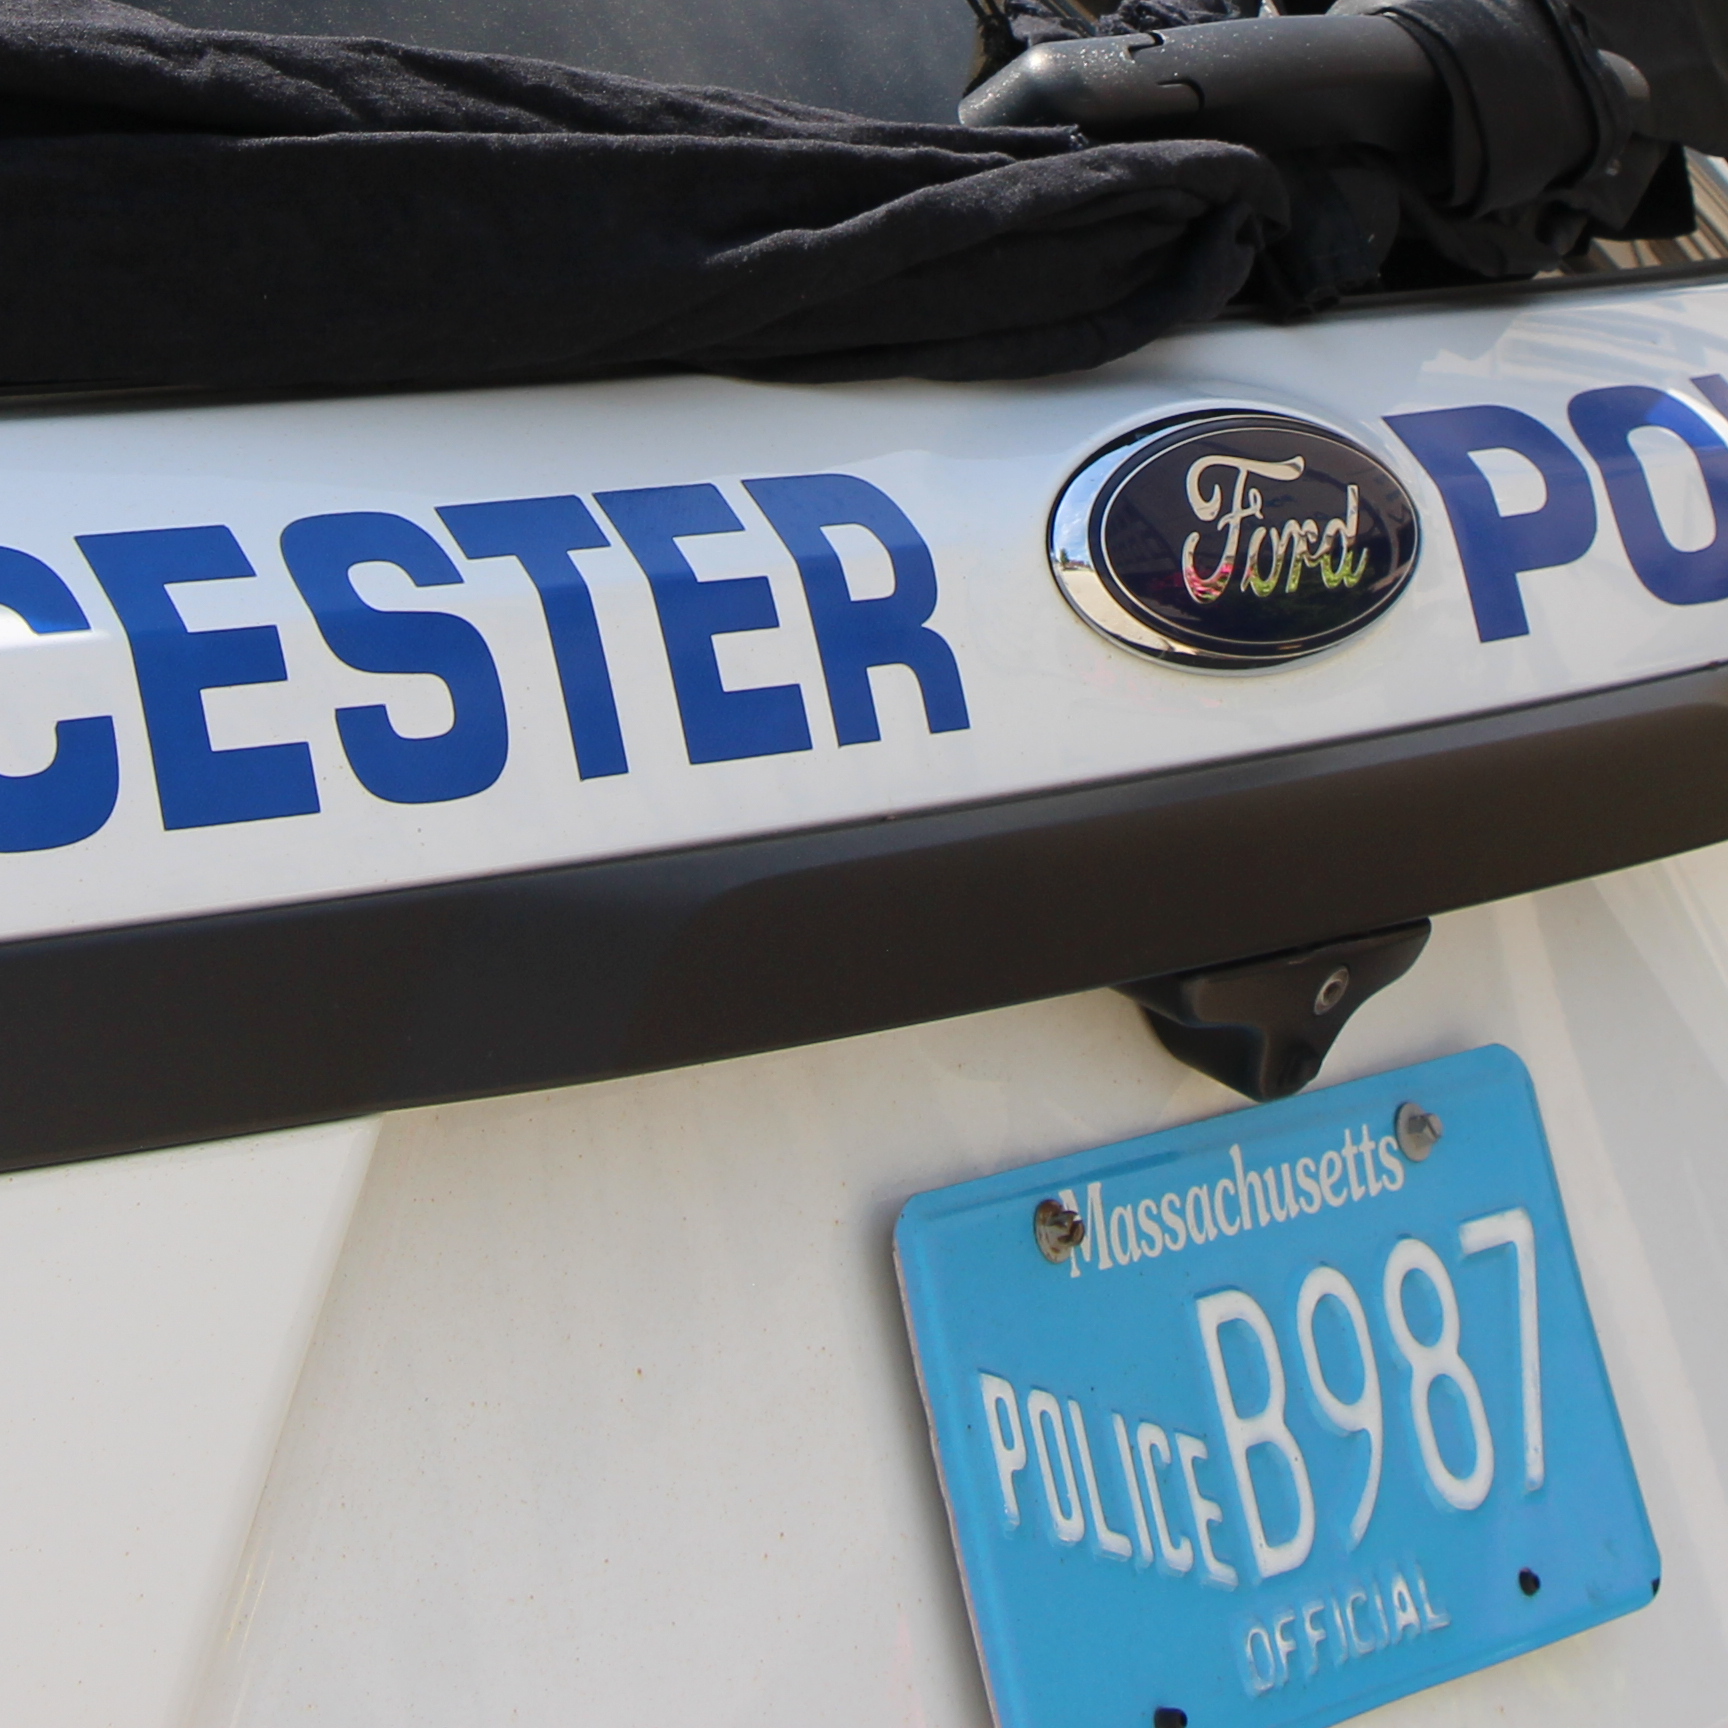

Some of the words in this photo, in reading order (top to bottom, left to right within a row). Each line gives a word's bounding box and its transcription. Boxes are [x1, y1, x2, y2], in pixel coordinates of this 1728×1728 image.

[1182, 454, 1369, 604] Ford
[1058, 1125, 1406, 1278] Massachusetts
[978, 1370, 1239, 1591] POLICE
[1195, 1208, 1545, 1580] B987
[1242, 1563, 1451, 1697] OFFICIAL
